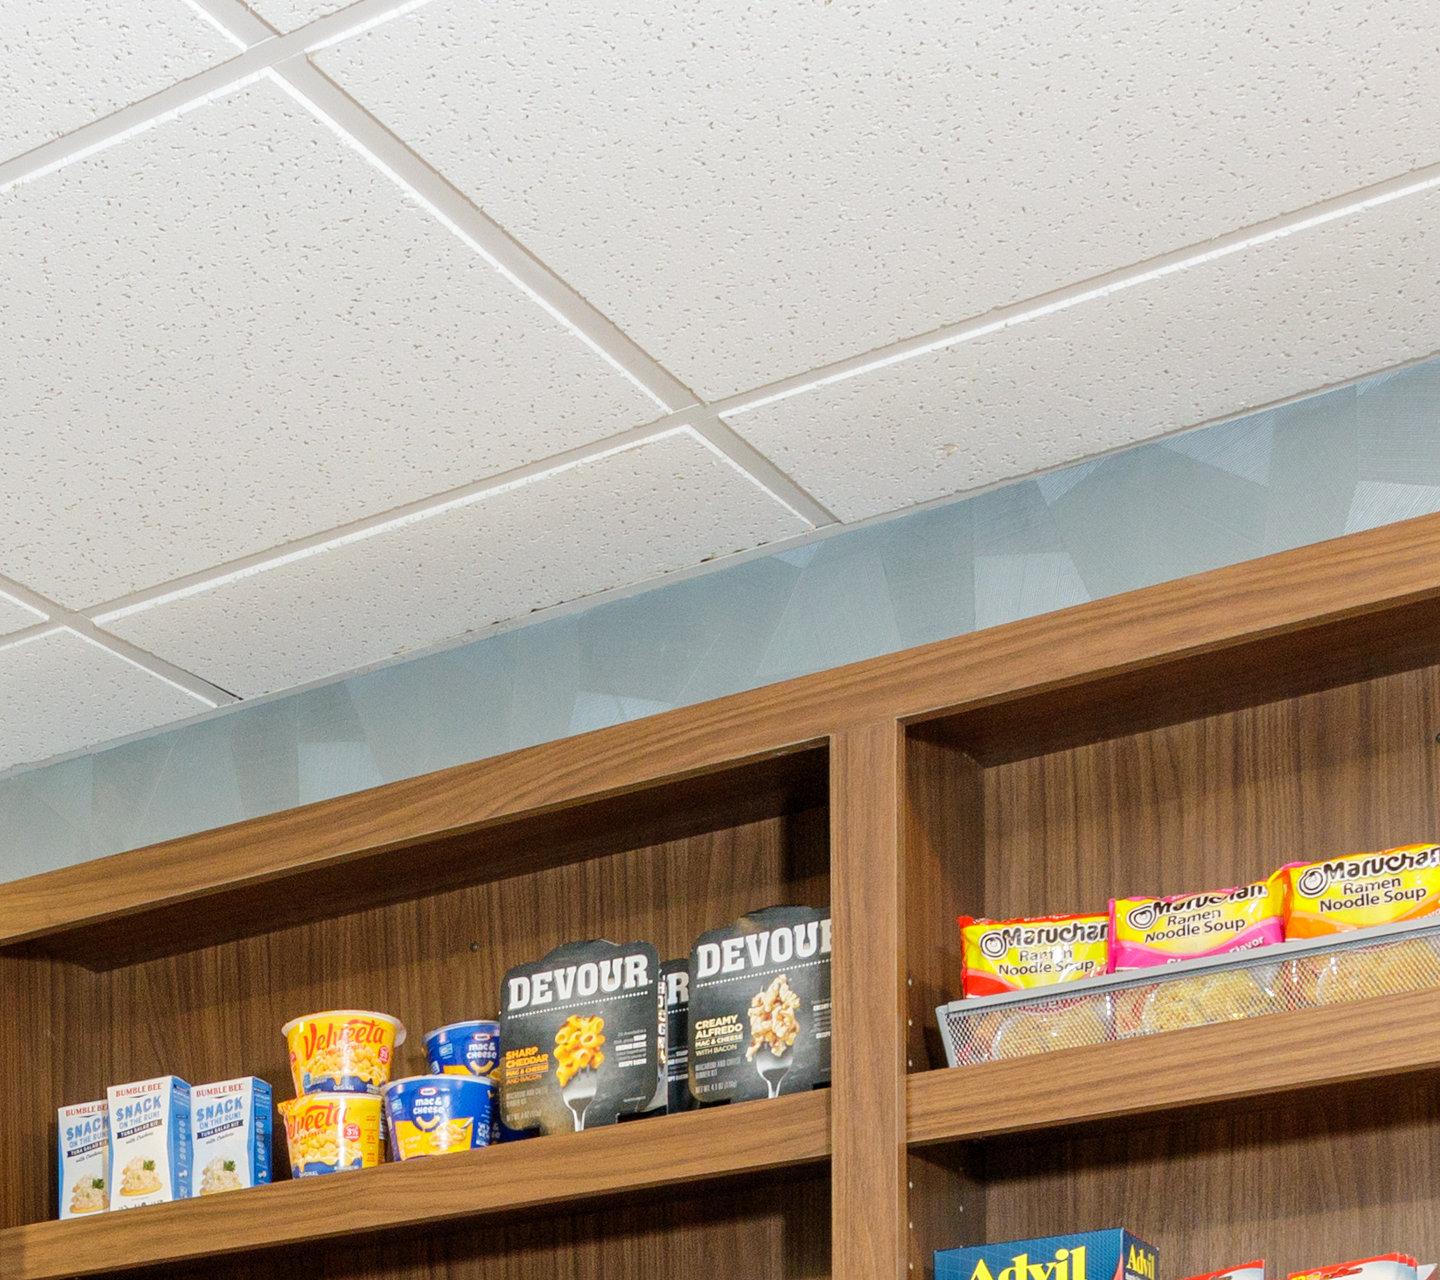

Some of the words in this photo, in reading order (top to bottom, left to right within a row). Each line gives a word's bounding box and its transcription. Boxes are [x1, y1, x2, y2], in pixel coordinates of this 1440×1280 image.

[1343, 876, 1401, 894] Ramen
[1320, 890, 1380, 912] Noodle
[1383, 885, 1427, 906] Soup
[695, 1015, 738, 1030] CREAMY
[695, 1022, 743, 1038] ALFREDO
[304, 1019, 384, 1061] Velveeta
[506, 1046, 538, 1060] SHARP
[506, 1055, 549, 1069] CHEDDAR
[115, 1085, 144, 1097] BUMBLE
[146, 1082, 163, 1093] BEE
[116, 1095, 162, 1122] SNACK
[196, 1097, 243, 1122] SNACK
